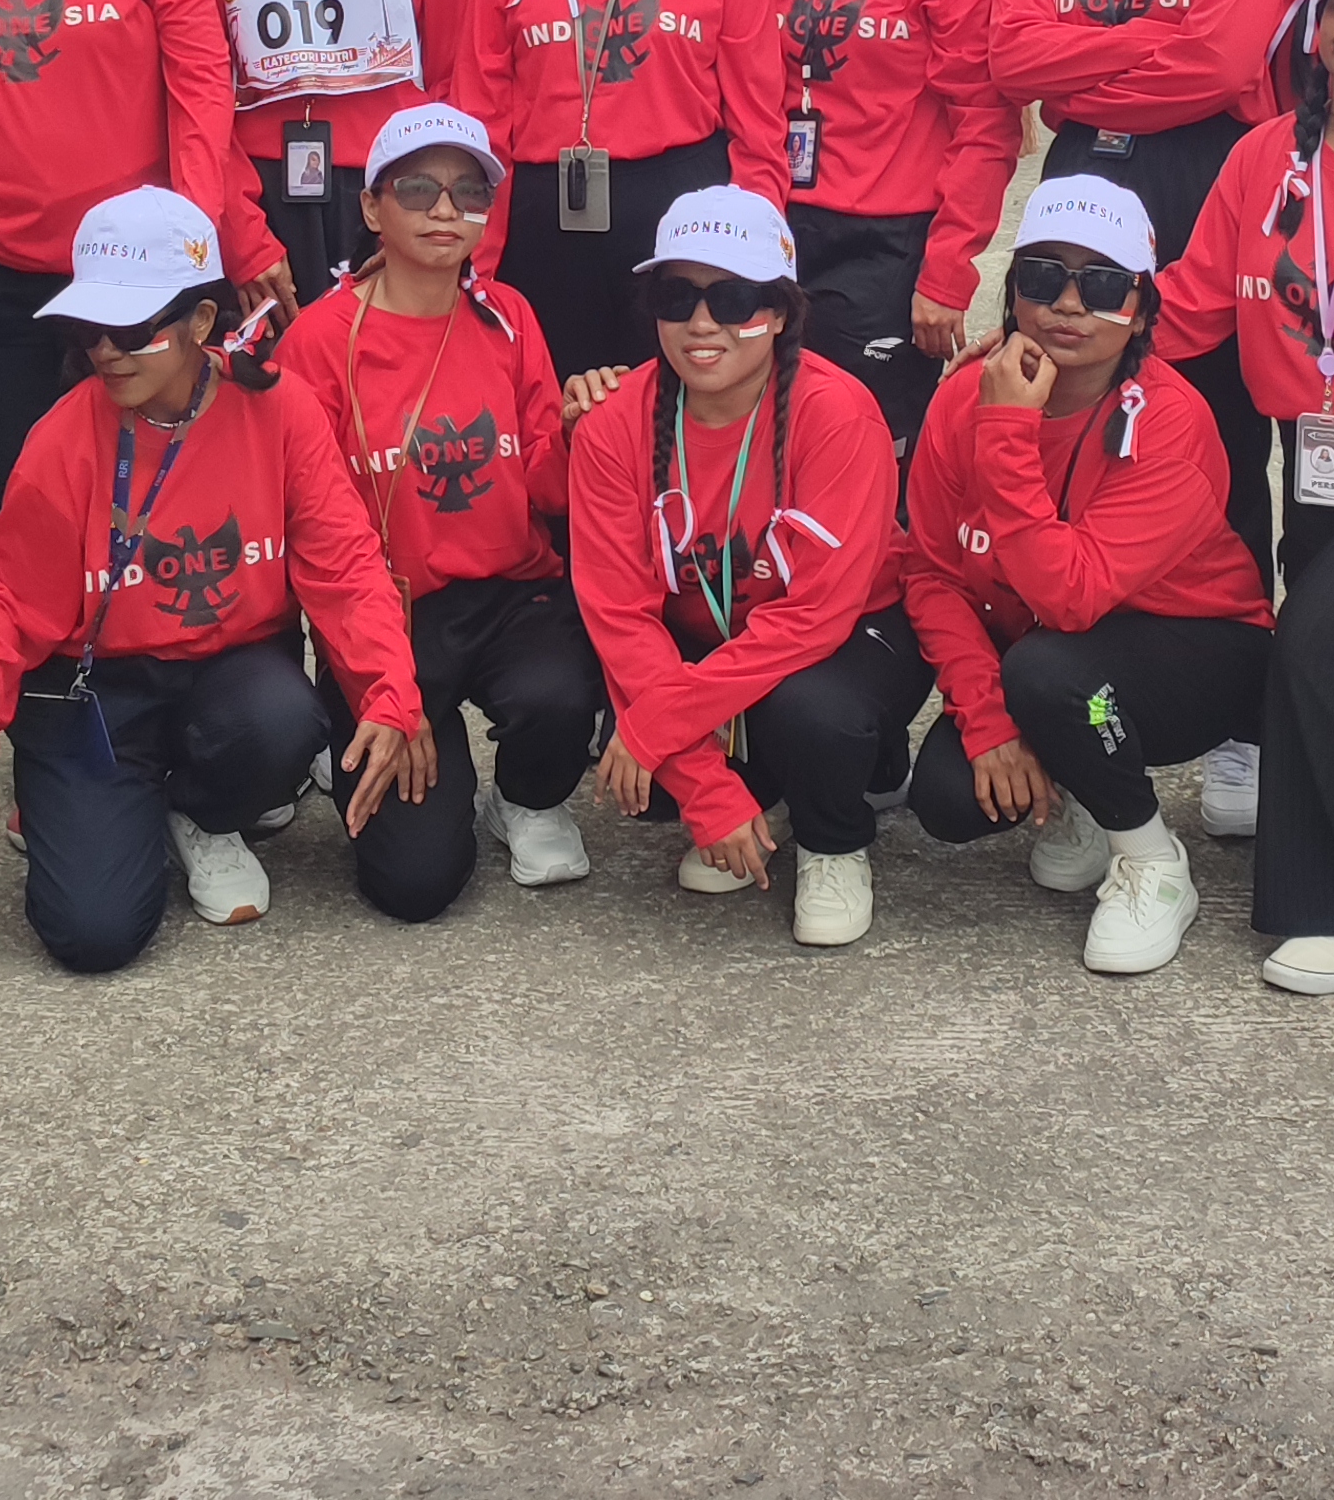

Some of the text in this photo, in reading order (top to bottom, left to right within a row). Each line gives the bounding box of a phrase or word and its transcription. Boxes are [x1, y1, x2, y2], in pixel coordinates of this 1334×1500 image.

[524, 13, 701, 49] INDONESIA
[263, 51, 319, 70] KATEGORI
[320, 49, 355, 64] PUTRI
[397, 115, 477, 141] INDONESIA
[1039, 199, 1124, 229] INDONESIA
[668, 219, 749, 242] INDONESIA
[77, 241, 149, 262] INDONESIA
[352, 433, 521, 476] INDONESI
